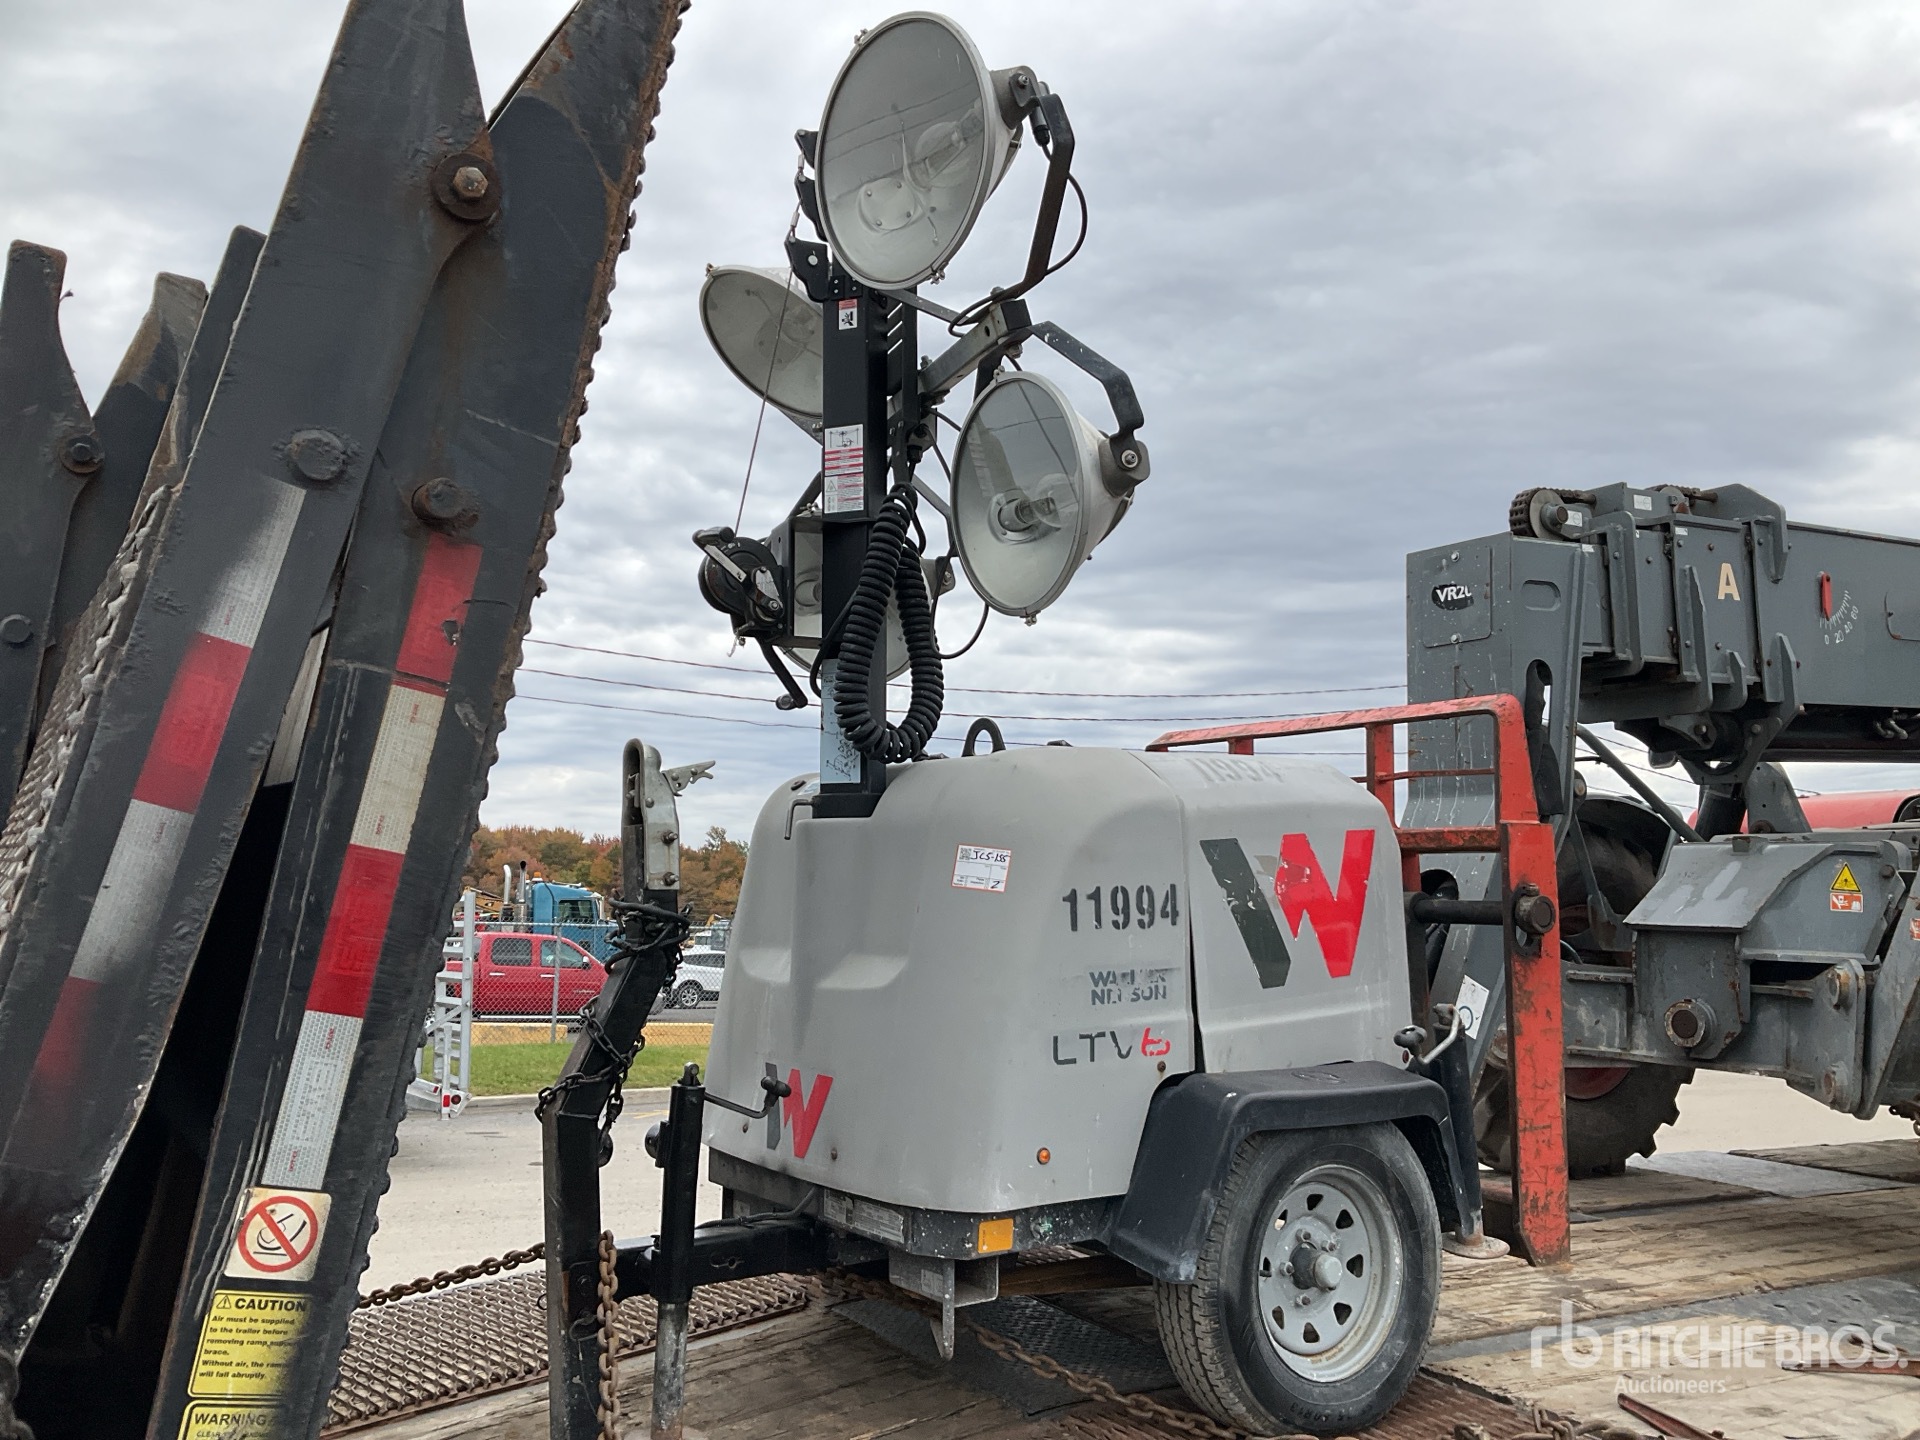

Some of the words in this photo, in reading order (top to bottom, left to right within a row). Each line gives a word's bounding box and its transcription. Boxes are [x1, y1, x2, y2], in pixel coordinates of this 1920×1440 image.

[1717, 563, 1740, 601] A
[1824, 634, 1830, 645] 0
[1834, 629, 1845, 644] 20
[1062, 883, 1180, 932] 11994
[234, 1297, 306, 1312] CAUTION
[206, 1338, 244, 1346] removing
[194, 1413, 266, 1426] WARNING
